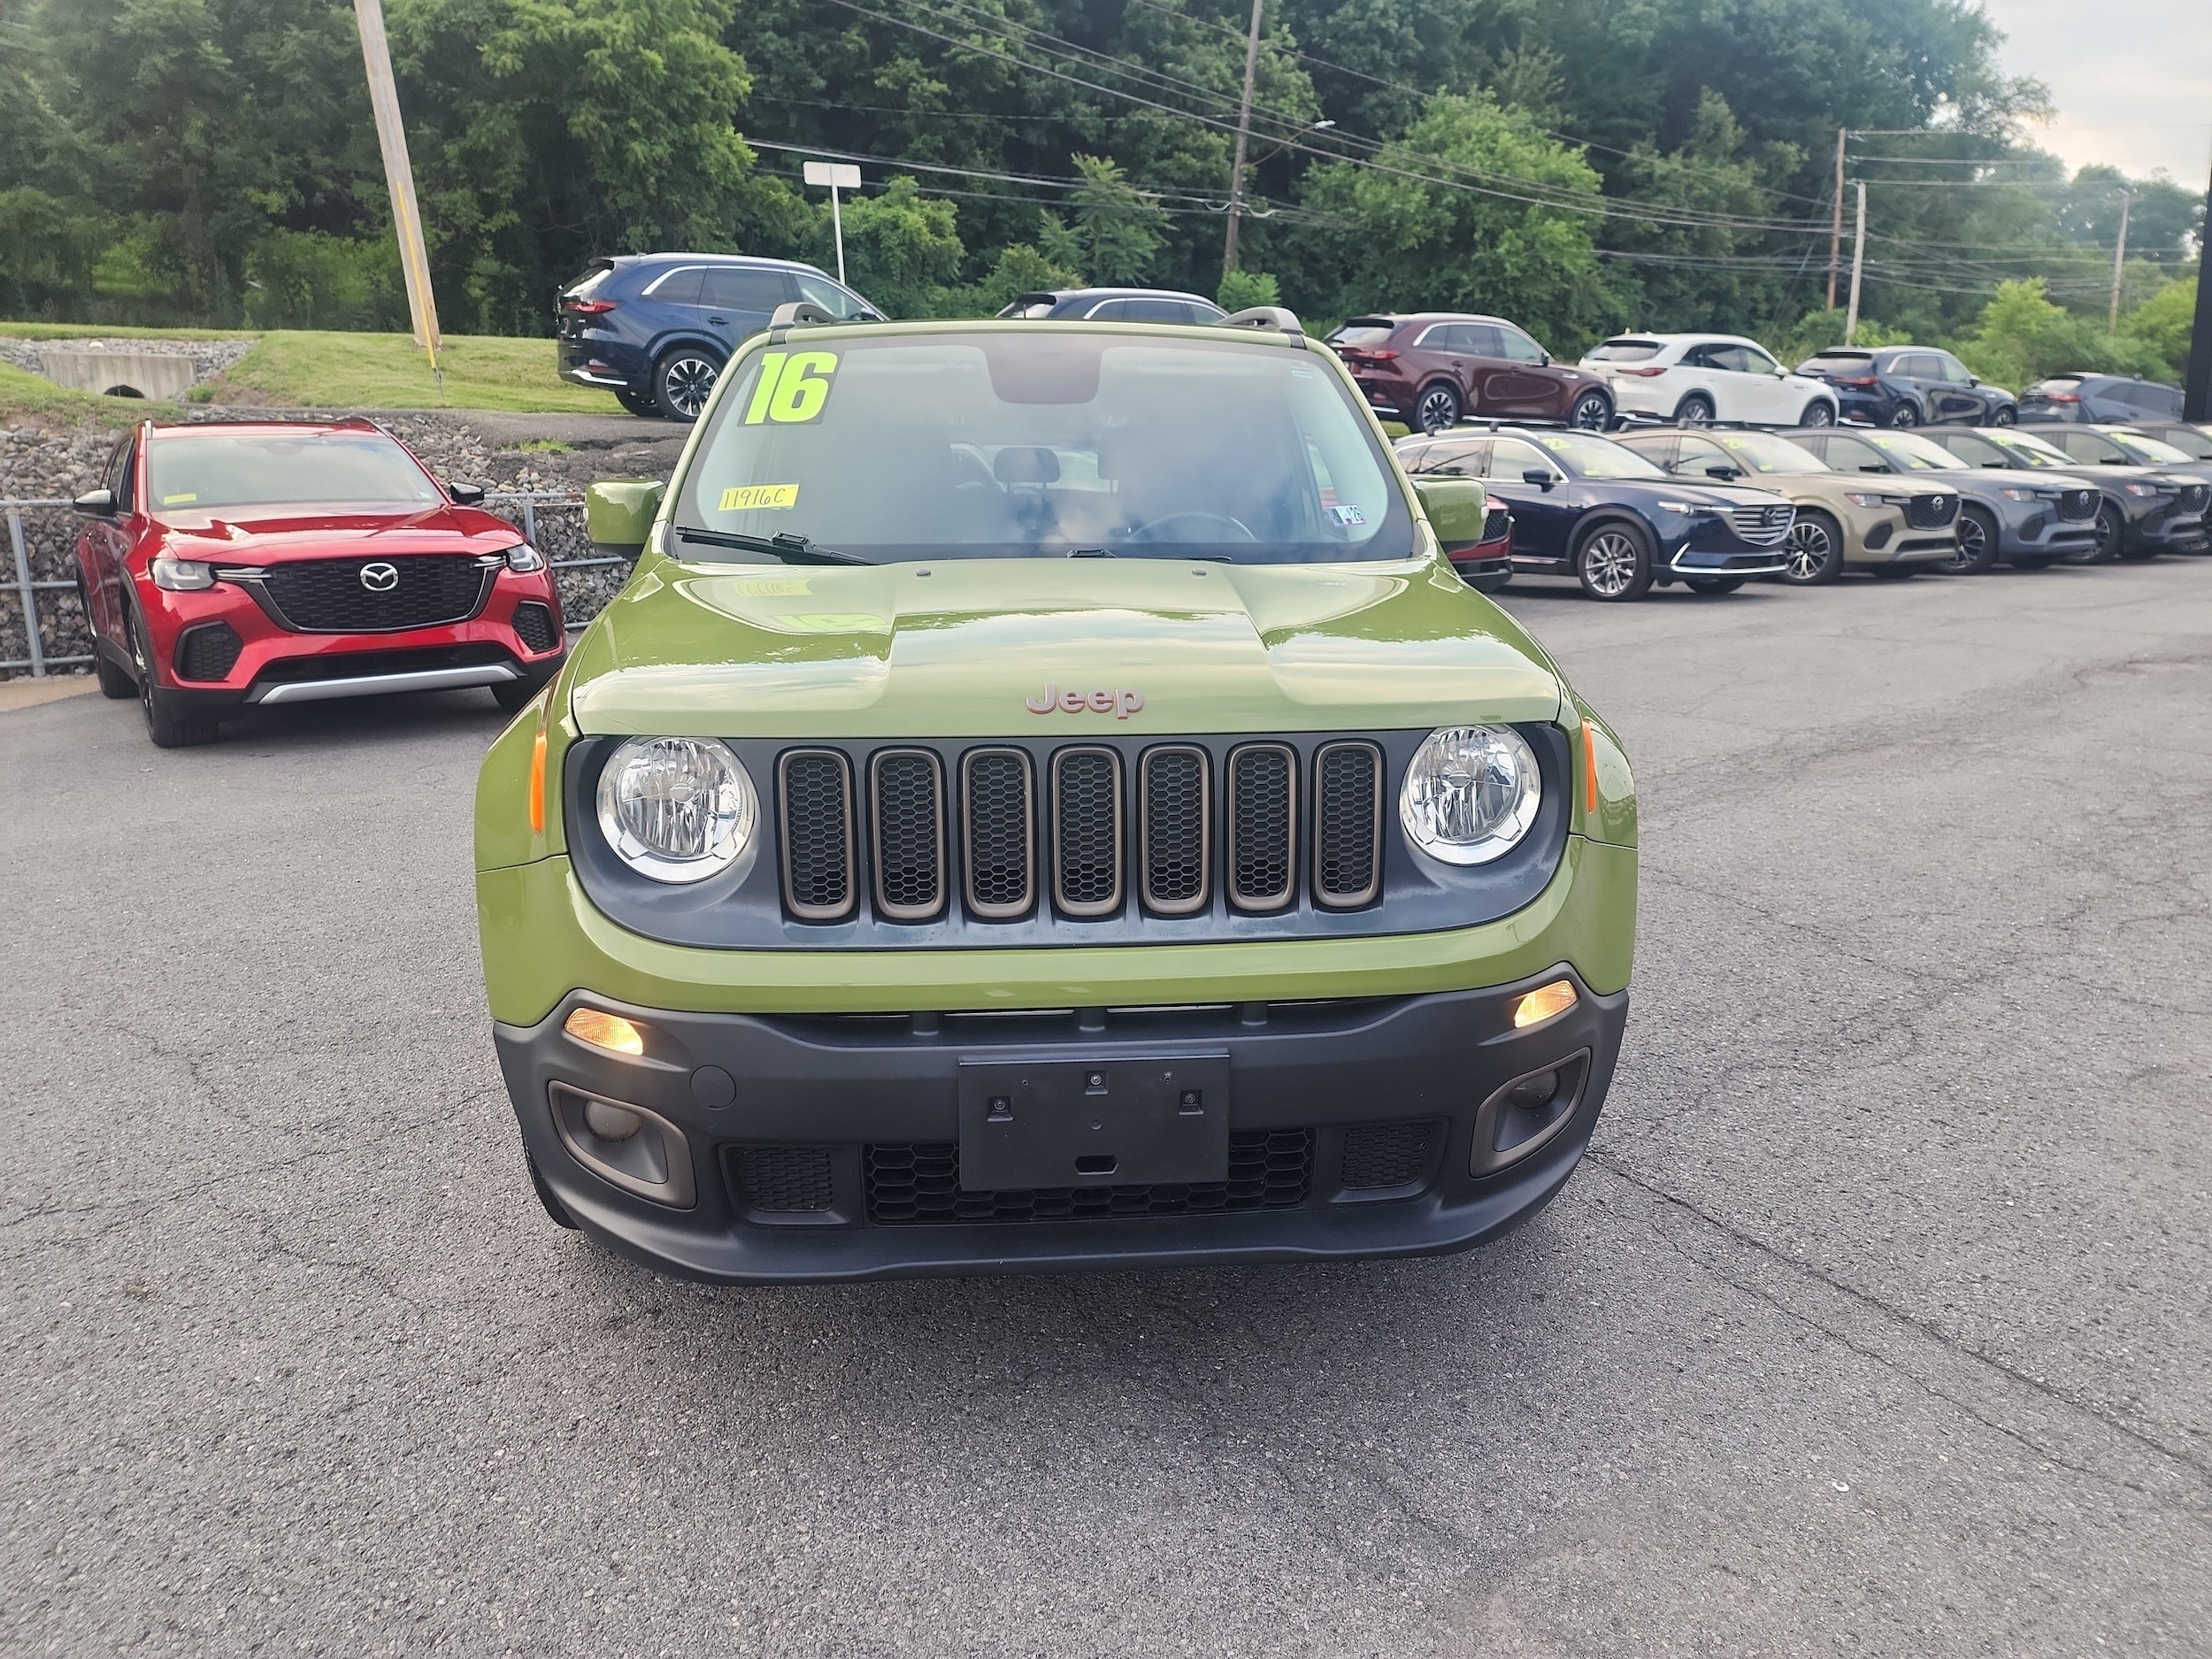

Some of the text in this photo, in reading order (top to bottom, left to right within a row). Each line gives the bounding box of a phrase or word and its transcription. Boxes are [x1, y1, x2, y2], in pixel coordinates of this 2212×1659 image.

[745, 352, 838, 425] 16
[724, 488, 786, 508] 11916C
[1349, 506, 1363, 522] 26
[1025, 683, 1144, 719] Jeep
